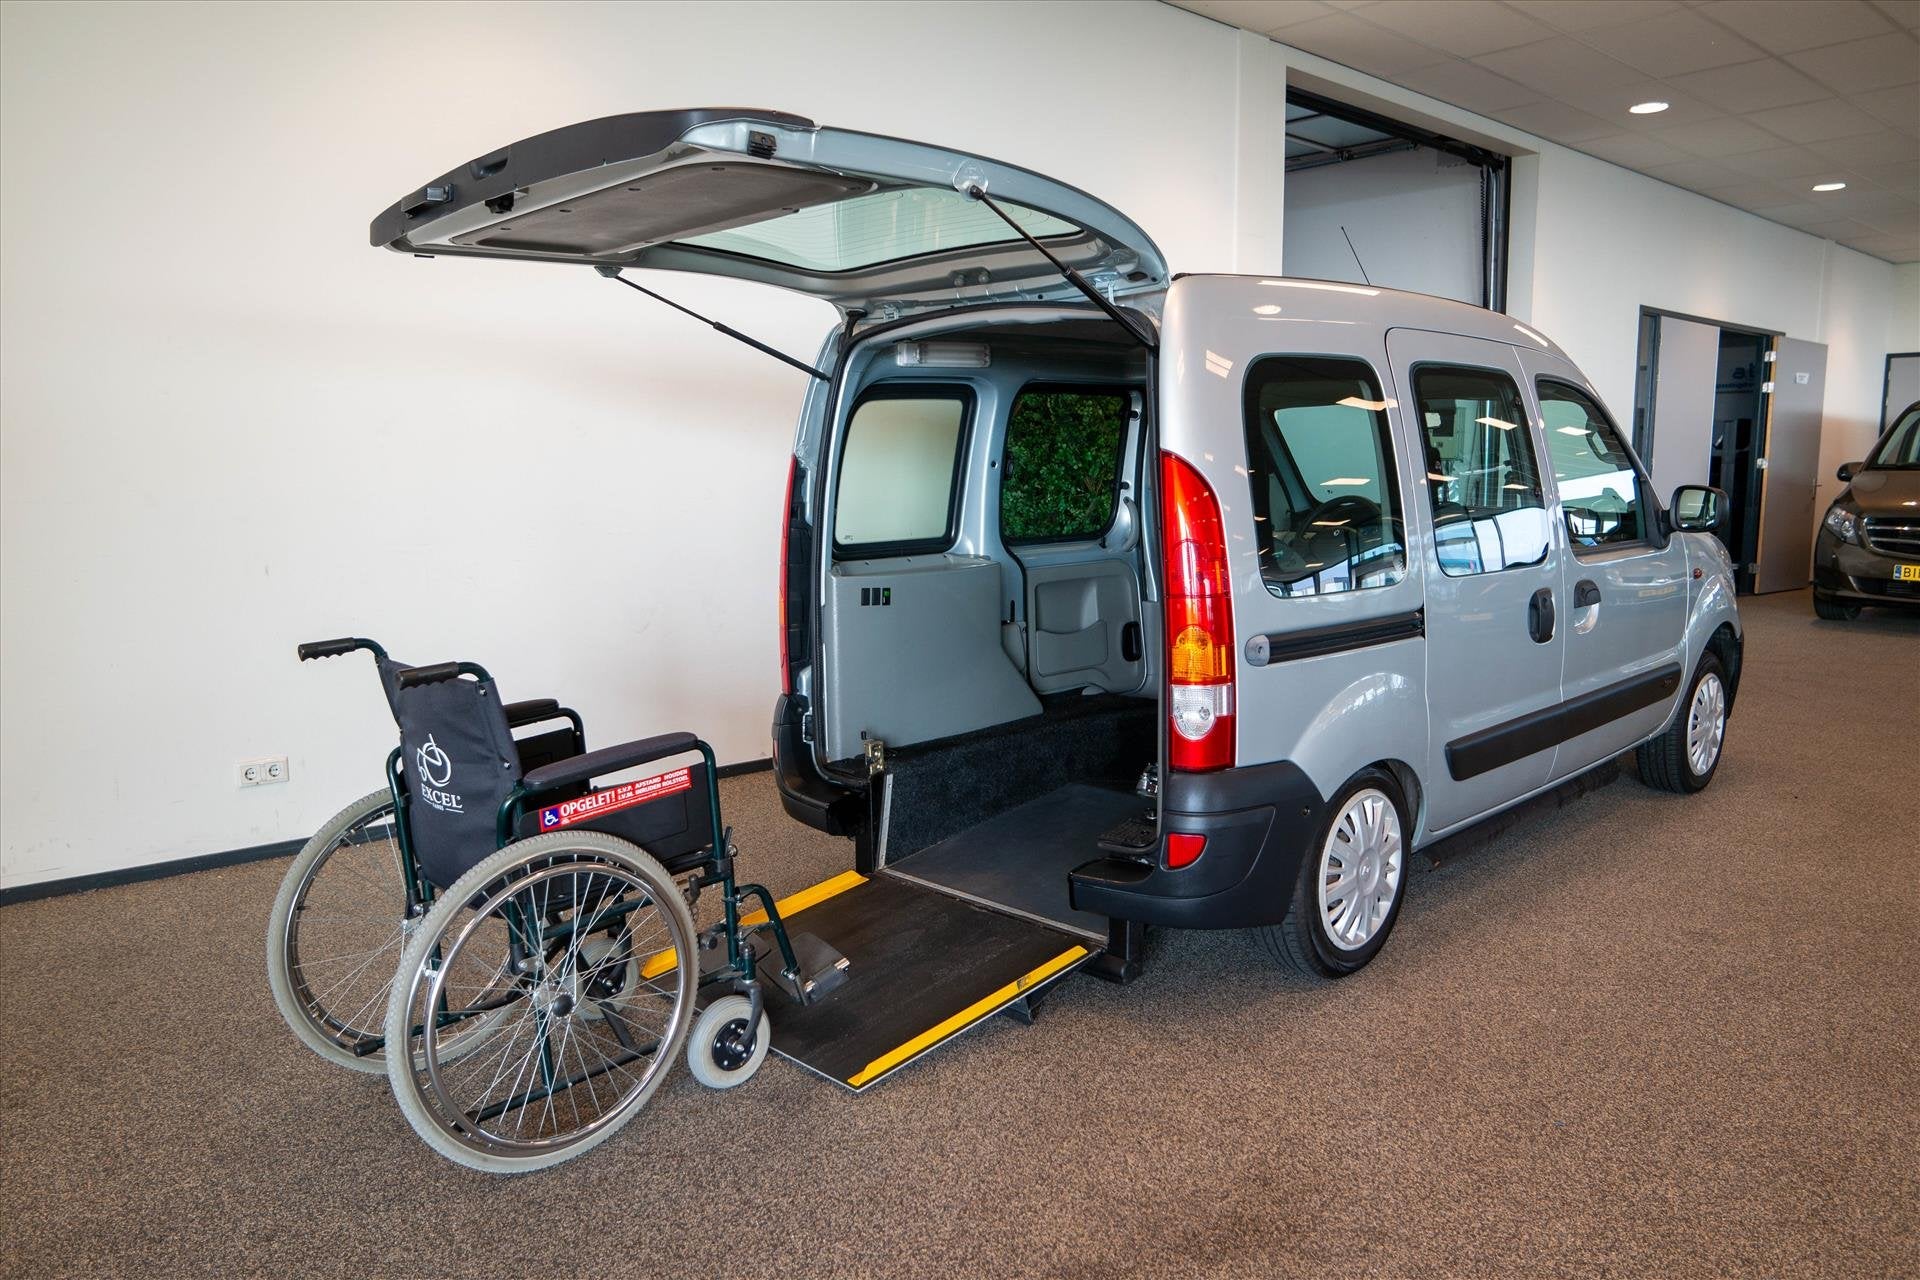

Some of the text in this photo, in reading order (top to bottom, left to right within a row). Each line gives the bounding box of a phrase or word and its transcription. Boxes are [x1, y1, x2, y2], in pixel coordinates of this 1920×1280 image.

[1904, 567, 1920, 579] BI
[635, 776, 661, 789] AFSTAND
[663, 768, 688, 780] HOUDEN
[662, 775, 689, 787] ROLSTOEL
[421, 783, 463, 808] EXCEL
[561, 790, 616, 817] OPGELET!
